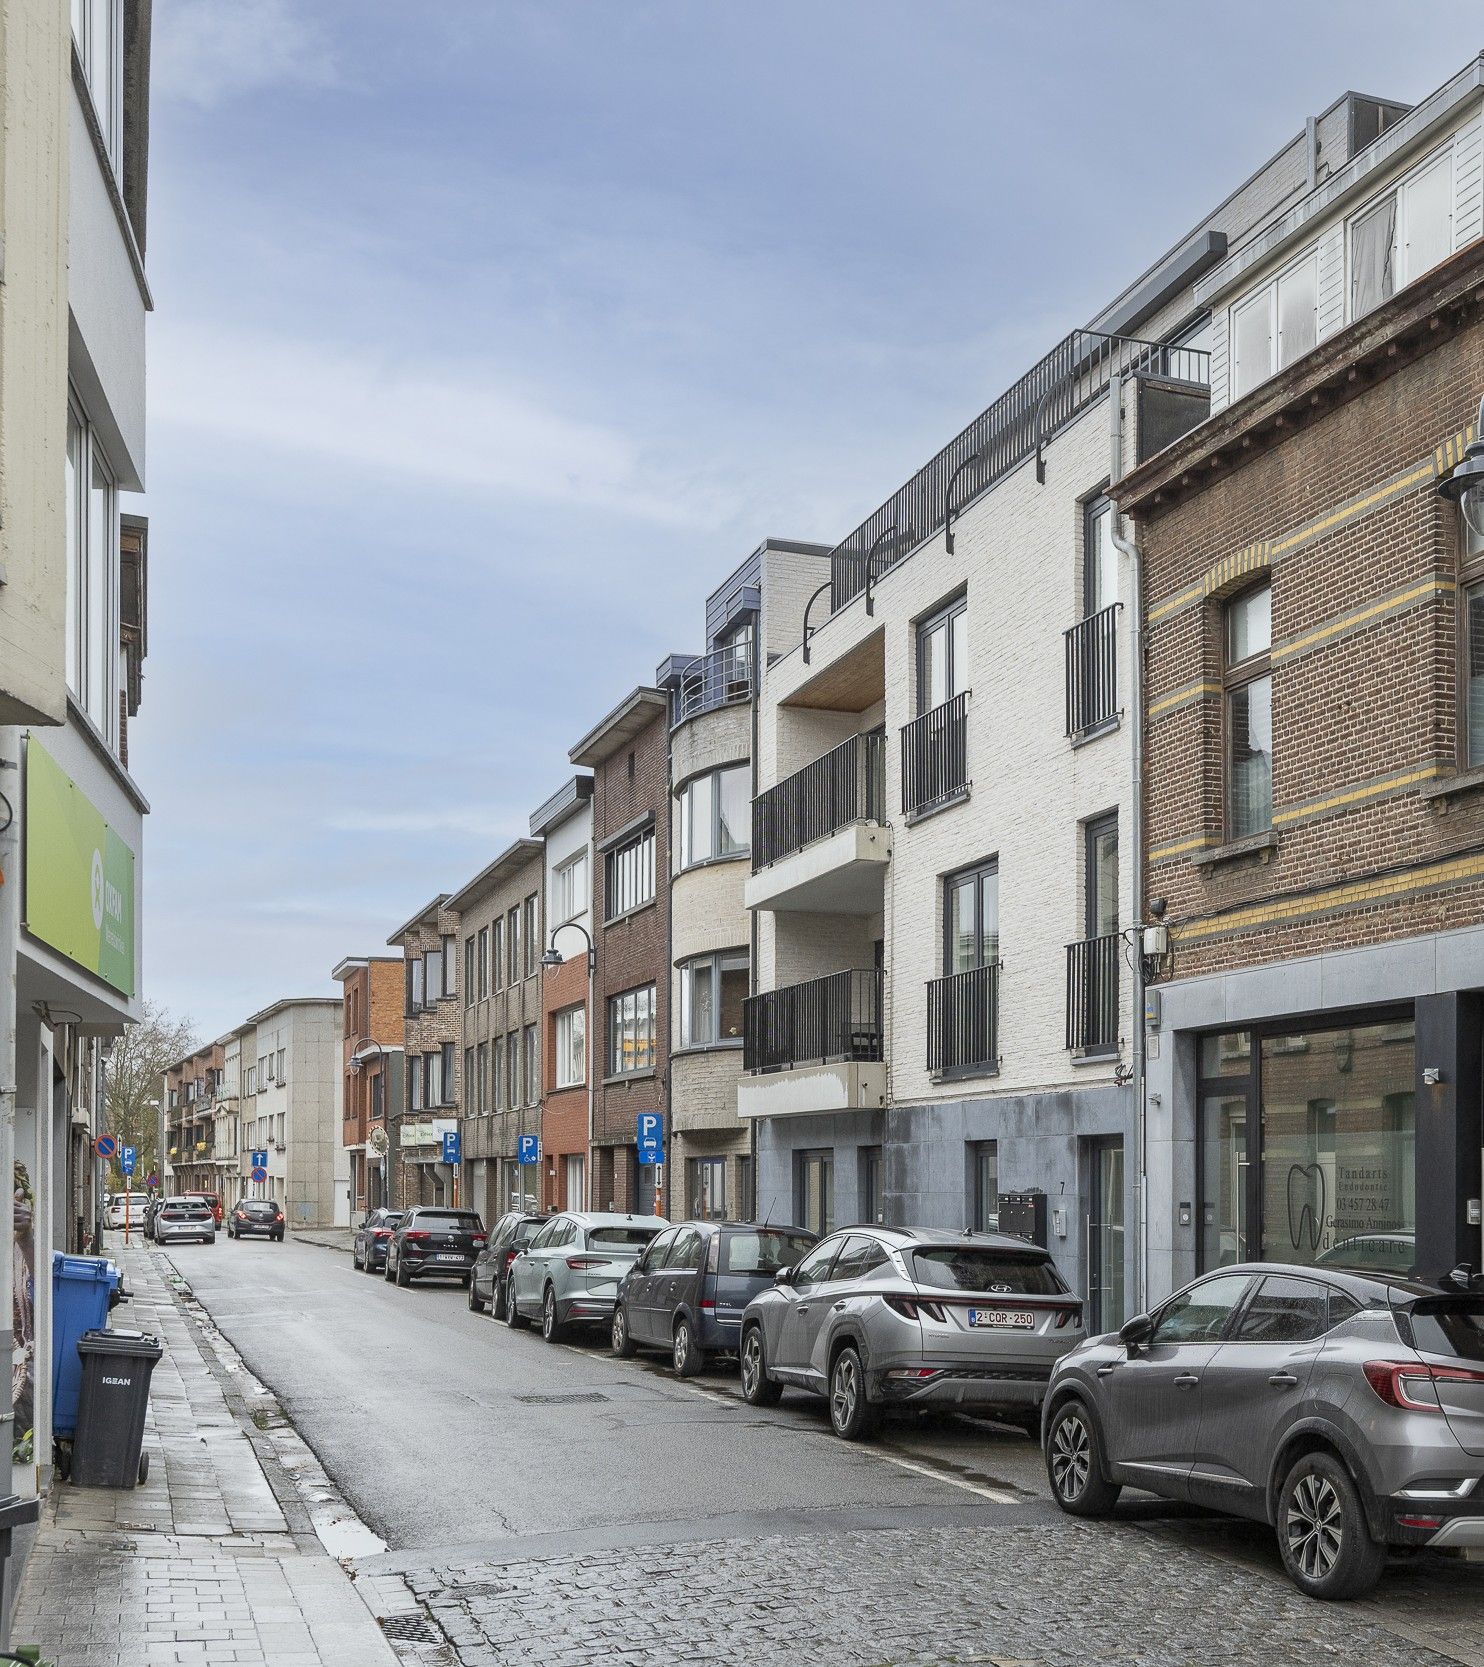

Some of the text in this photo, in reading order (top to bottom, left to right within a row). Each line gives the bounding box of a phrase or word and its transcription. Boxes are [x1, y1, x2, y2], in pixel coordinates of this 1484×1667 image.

[643, 1116, 656, 1136] P
[446, 1133, 456, 1146] P
[522, 1137, 534, 1152] P
[125, 1148, 132, 1159] P
[1338, 1166, 1389, 1179] Tandarts
[1060, 1181, 1065, 1195] 7
[1322, 1231, 1405, 1254] denticare
[102, 1376, 131, 1386] IGEAN
